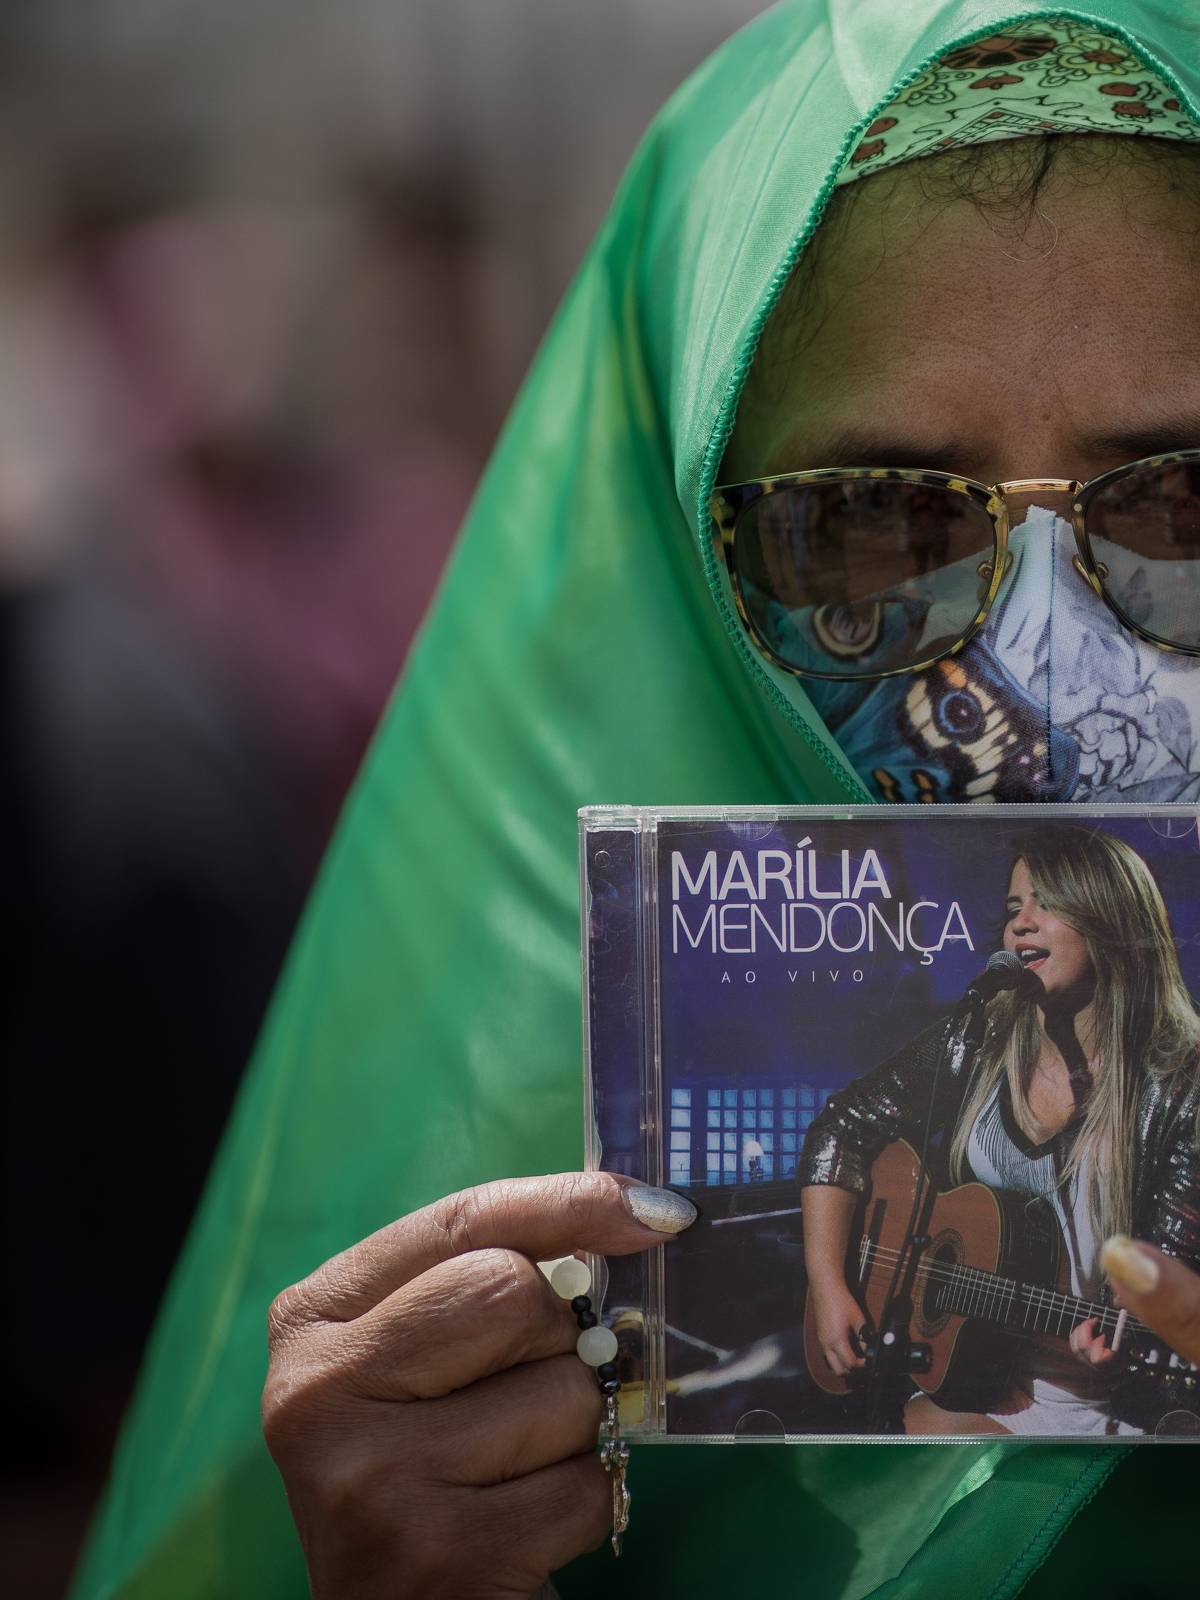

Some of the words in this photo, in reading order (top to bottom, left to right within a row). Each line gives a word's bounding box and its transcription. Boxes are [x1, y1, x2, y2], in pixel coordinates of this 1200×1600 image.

[671, 836, 891, 900] MARÍLIA
[672, 902, 975, 965] MENDONÇA
[721, 970, 756, 984] AO
[787, 969, 864, 983] VIVO
